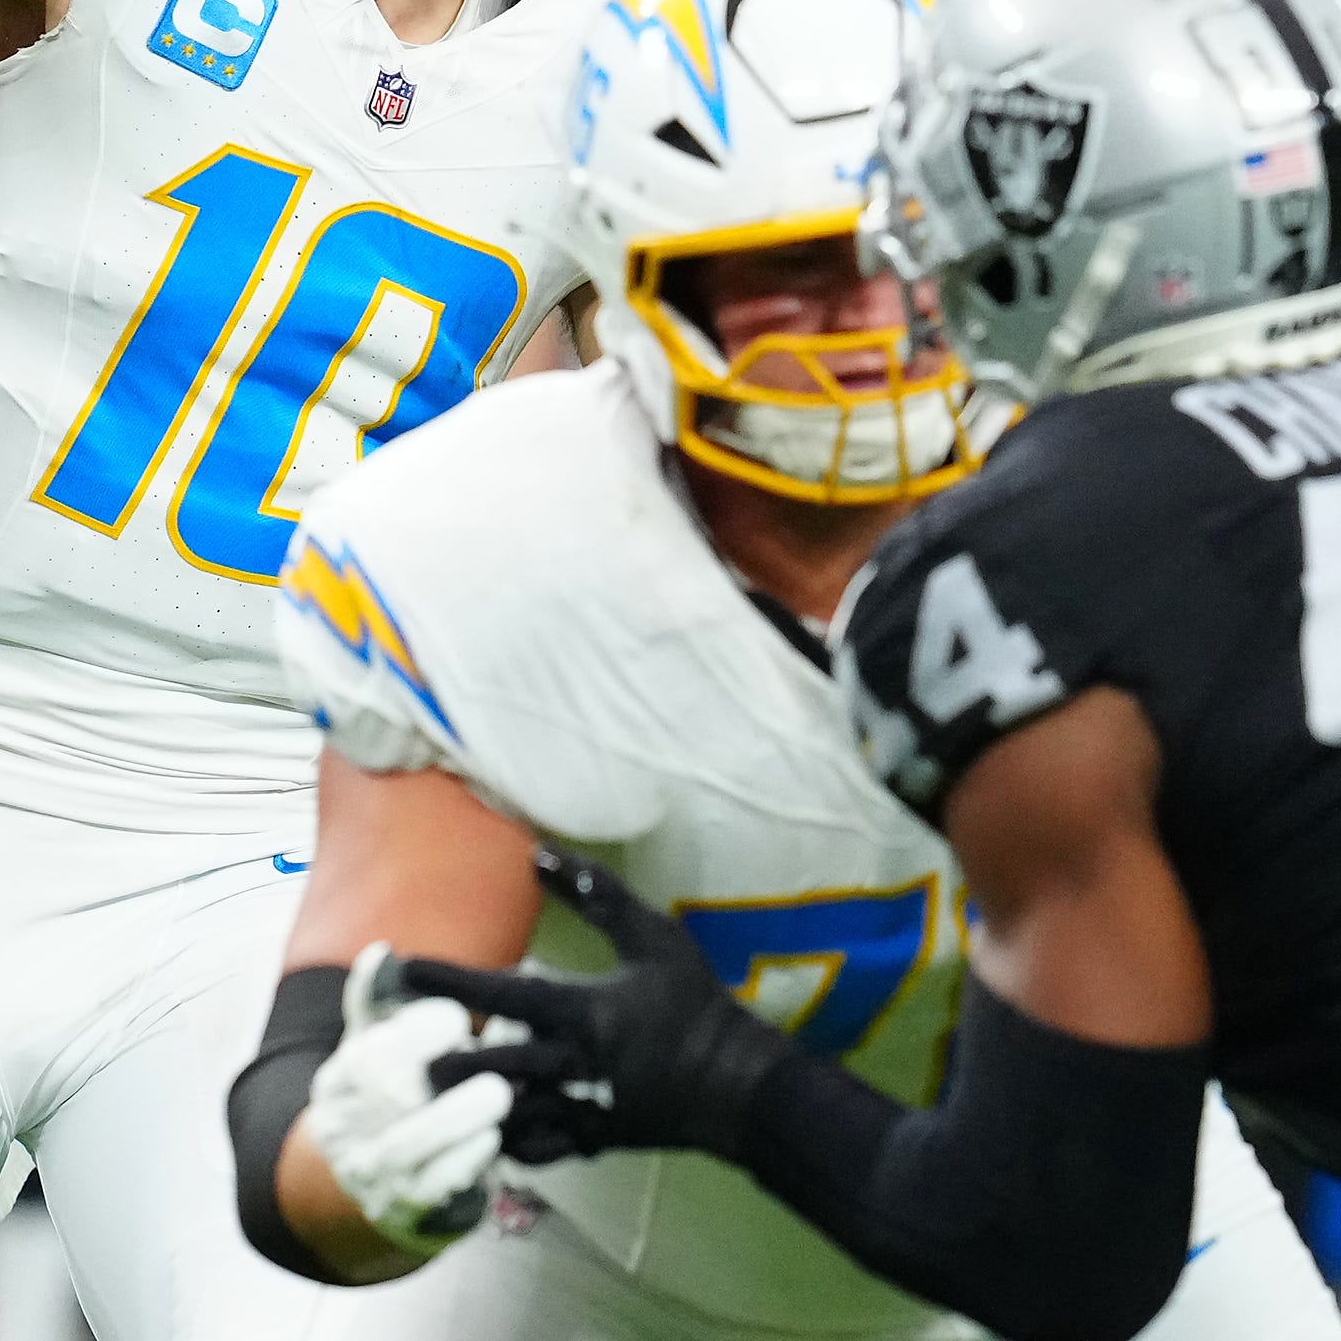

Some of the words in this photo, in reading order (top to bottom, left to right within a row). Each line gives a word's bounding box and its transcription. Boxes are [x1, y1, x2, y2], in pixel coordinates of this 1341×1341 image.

[372, 89, 405, 121] NFL
[29, 142, 527, 587] 10
[671, 872, 979, 1111] 7
